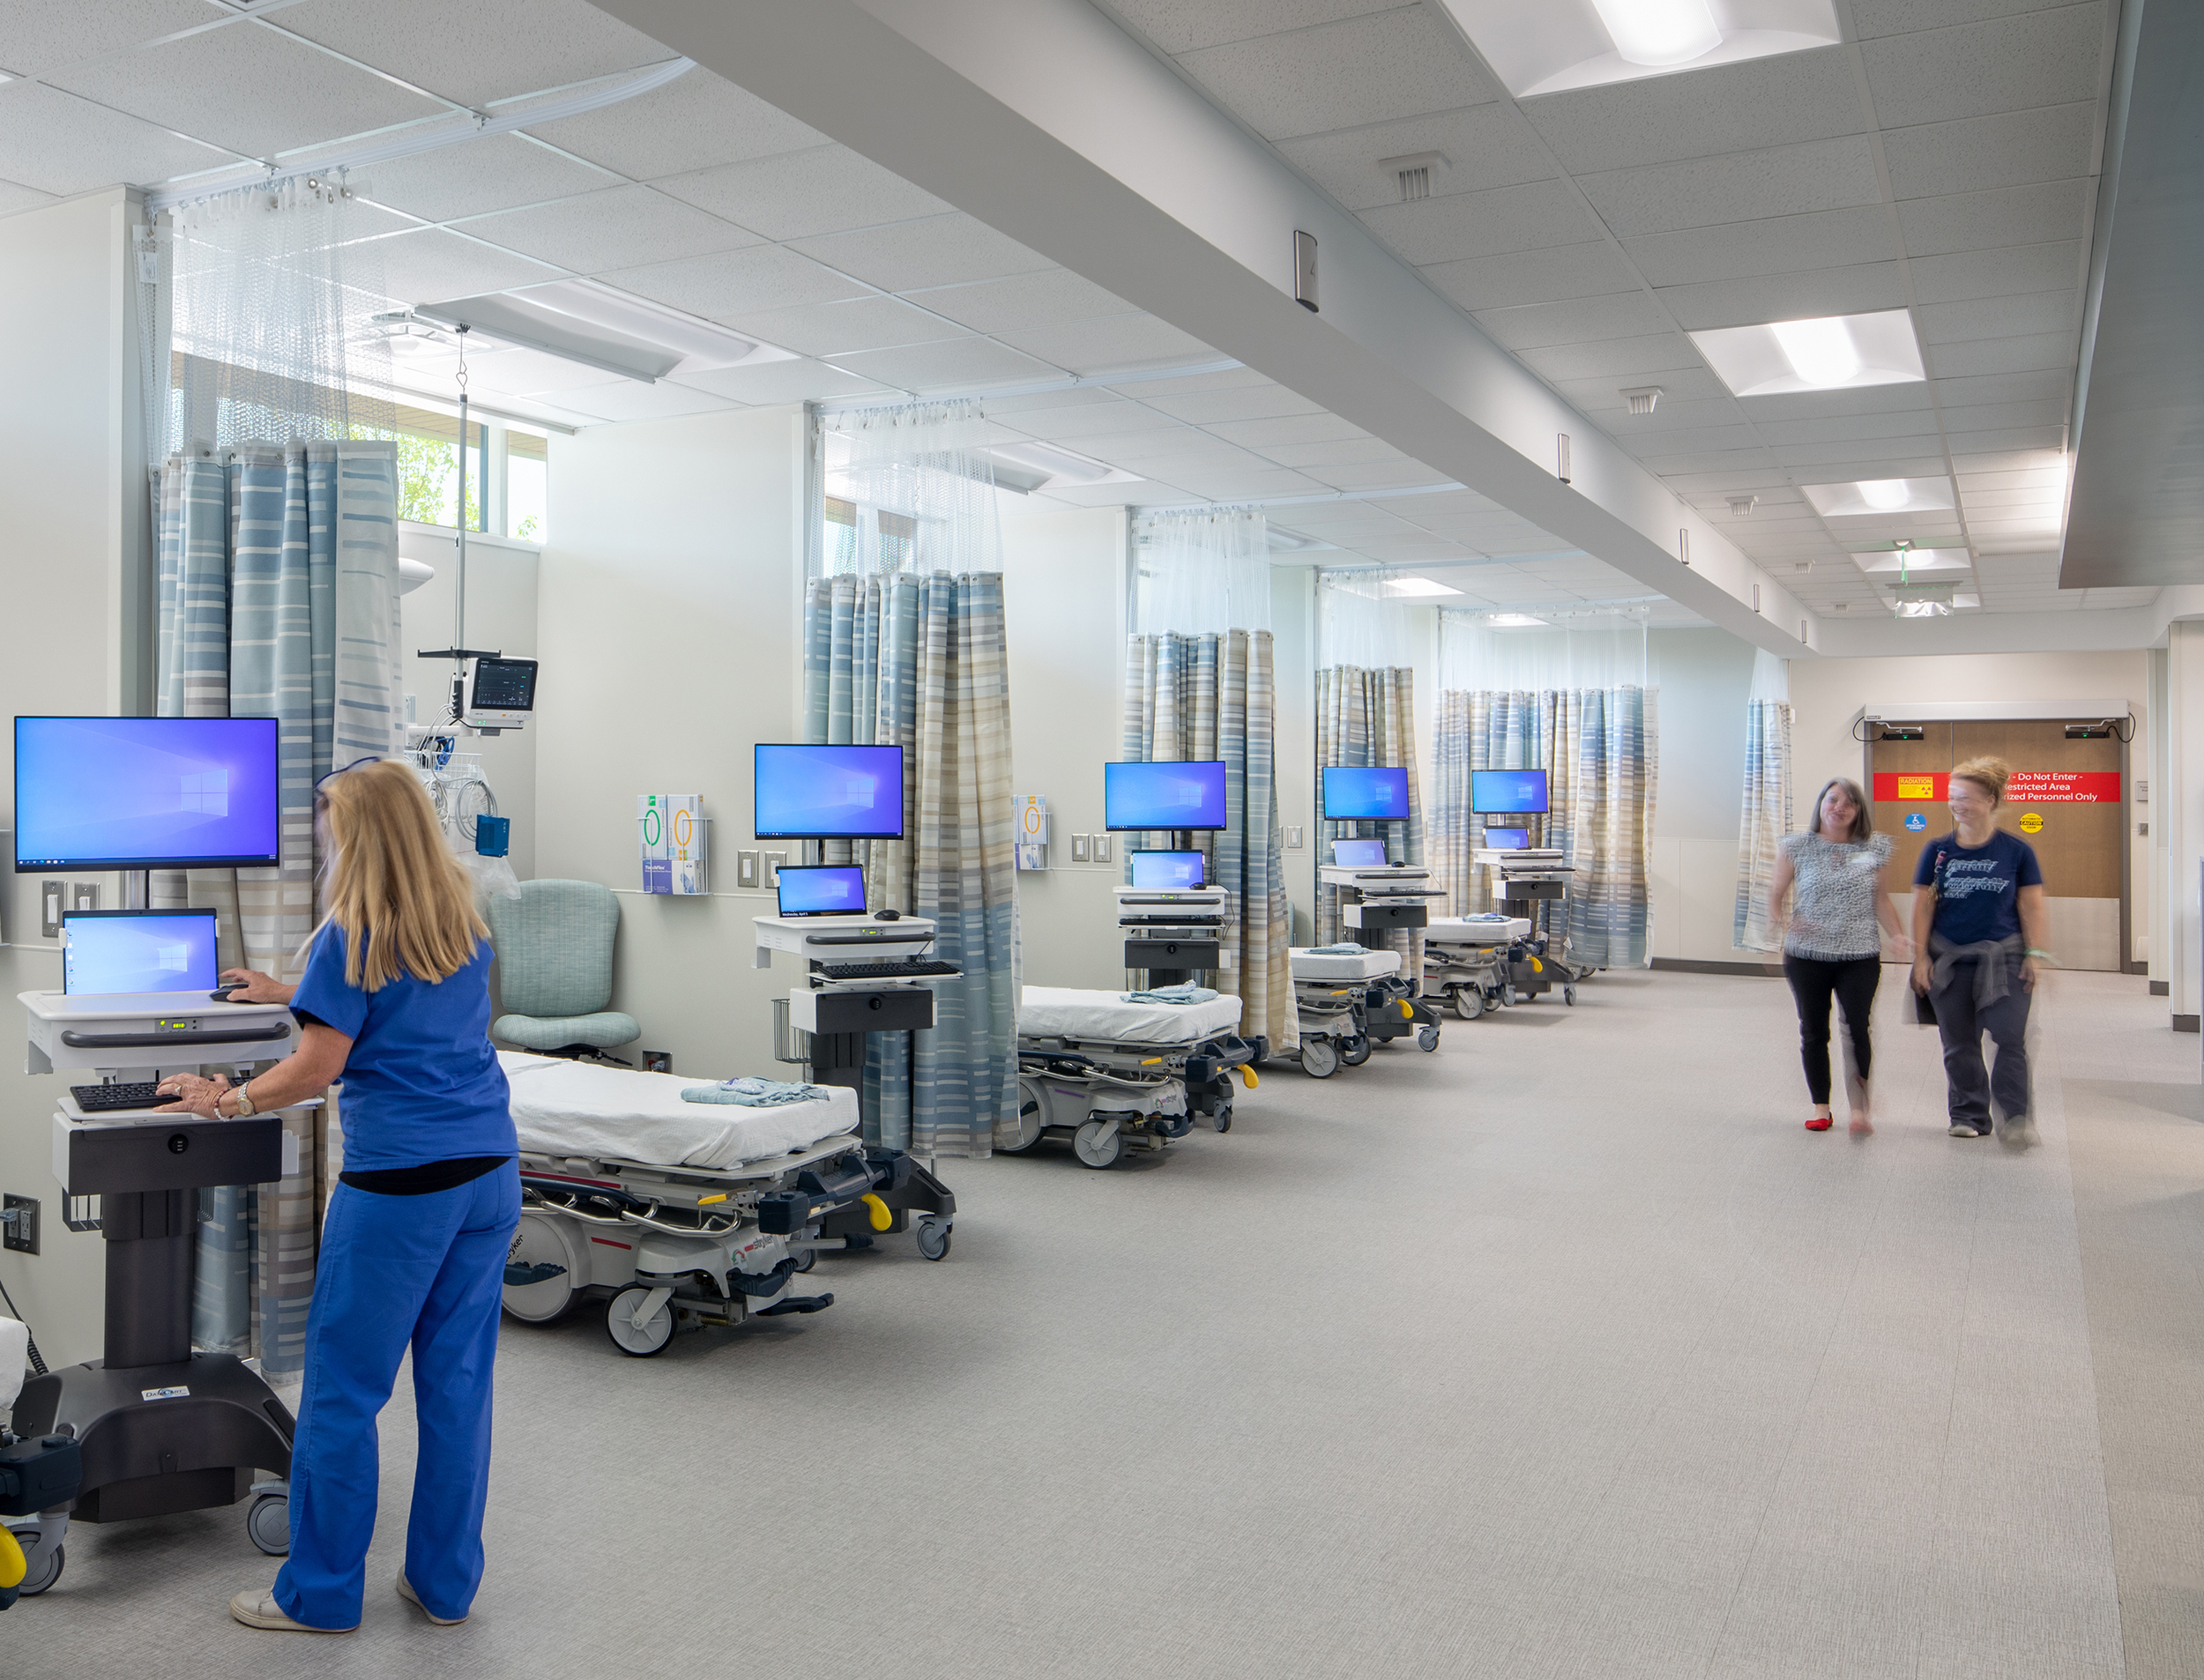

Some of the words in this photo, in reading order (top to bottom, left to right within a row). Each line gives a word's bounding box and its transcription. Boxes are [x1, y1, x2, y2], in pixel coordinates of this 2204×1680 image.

[2075, 792, 2097, 802] Only
[506, 1234, 524, 1262] ryker
[753, 1235, 773, 1250] stryker
